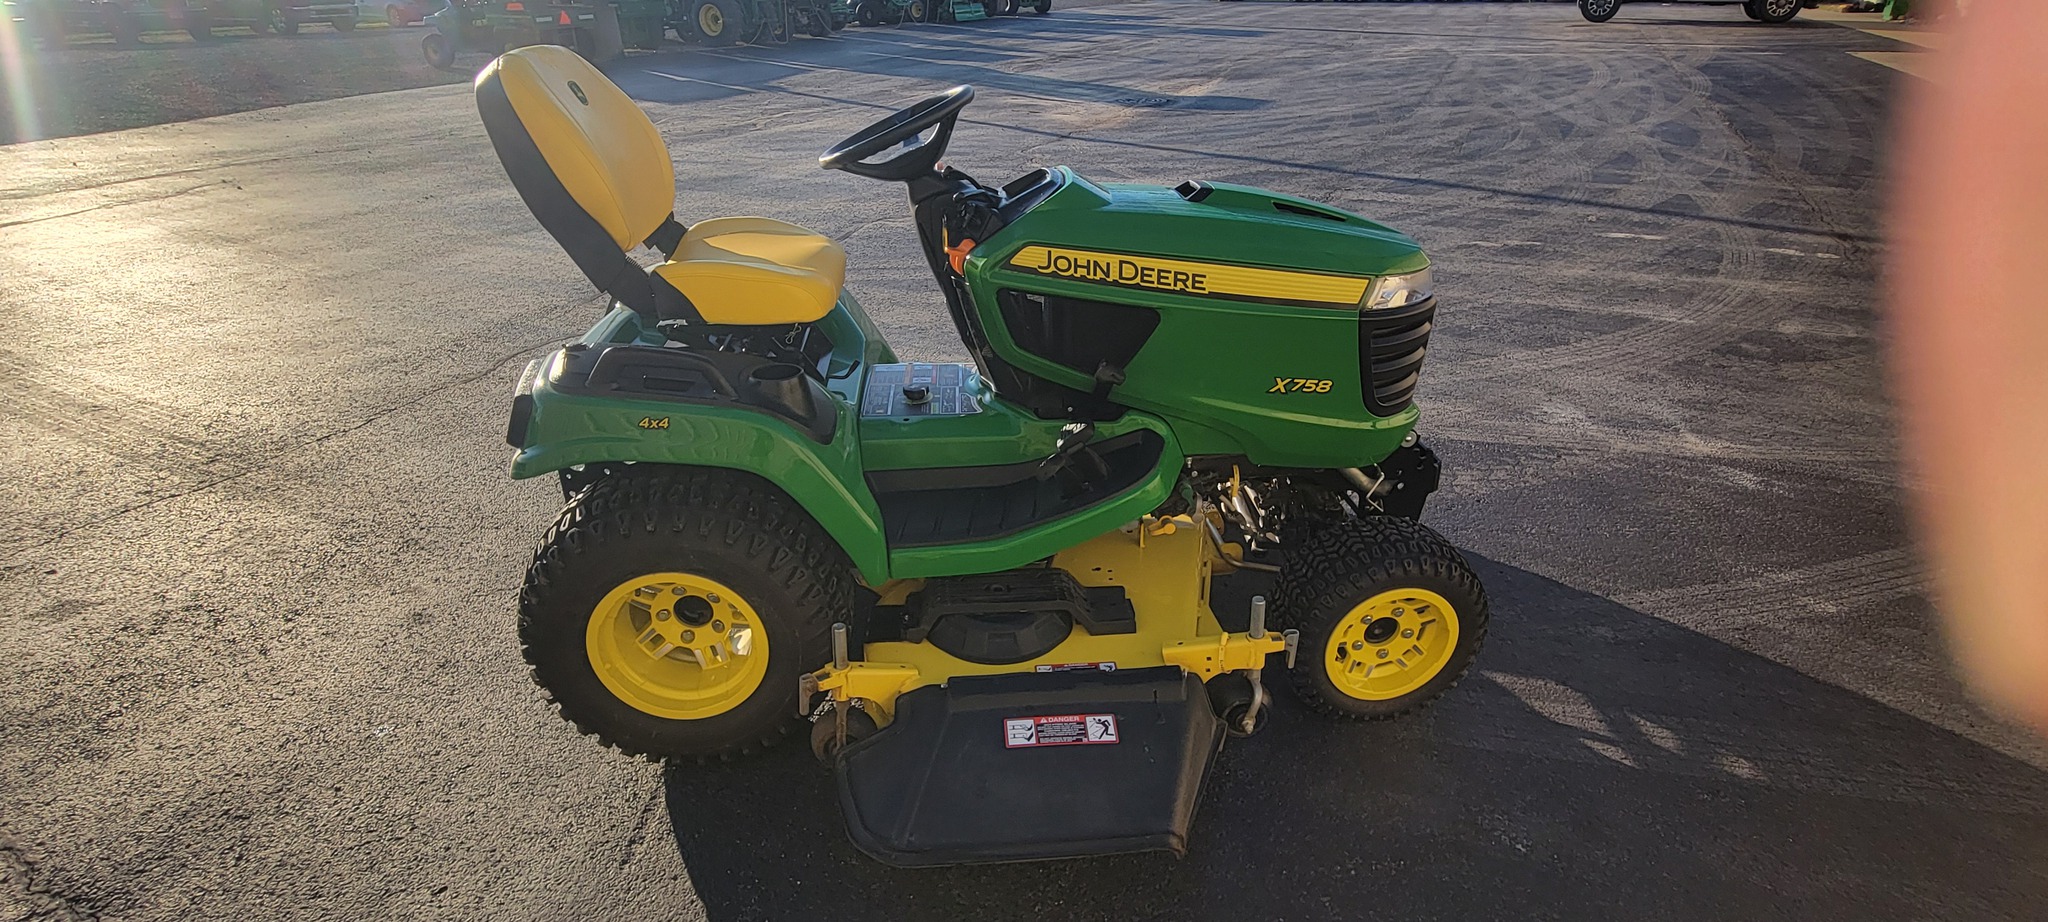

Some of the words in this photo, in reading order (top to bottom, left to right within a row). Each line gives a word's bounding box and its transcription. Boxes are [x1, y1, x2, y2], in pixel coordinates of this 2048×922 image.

[1037, 251, 1110, 280] JOHN
[1119, 261, 1207, 291] DEERE
[1268, 376, 1333, 394] X758
[639, 416, 669, 429] 4x4
[1048, 715, 1080, 723] DANGER
